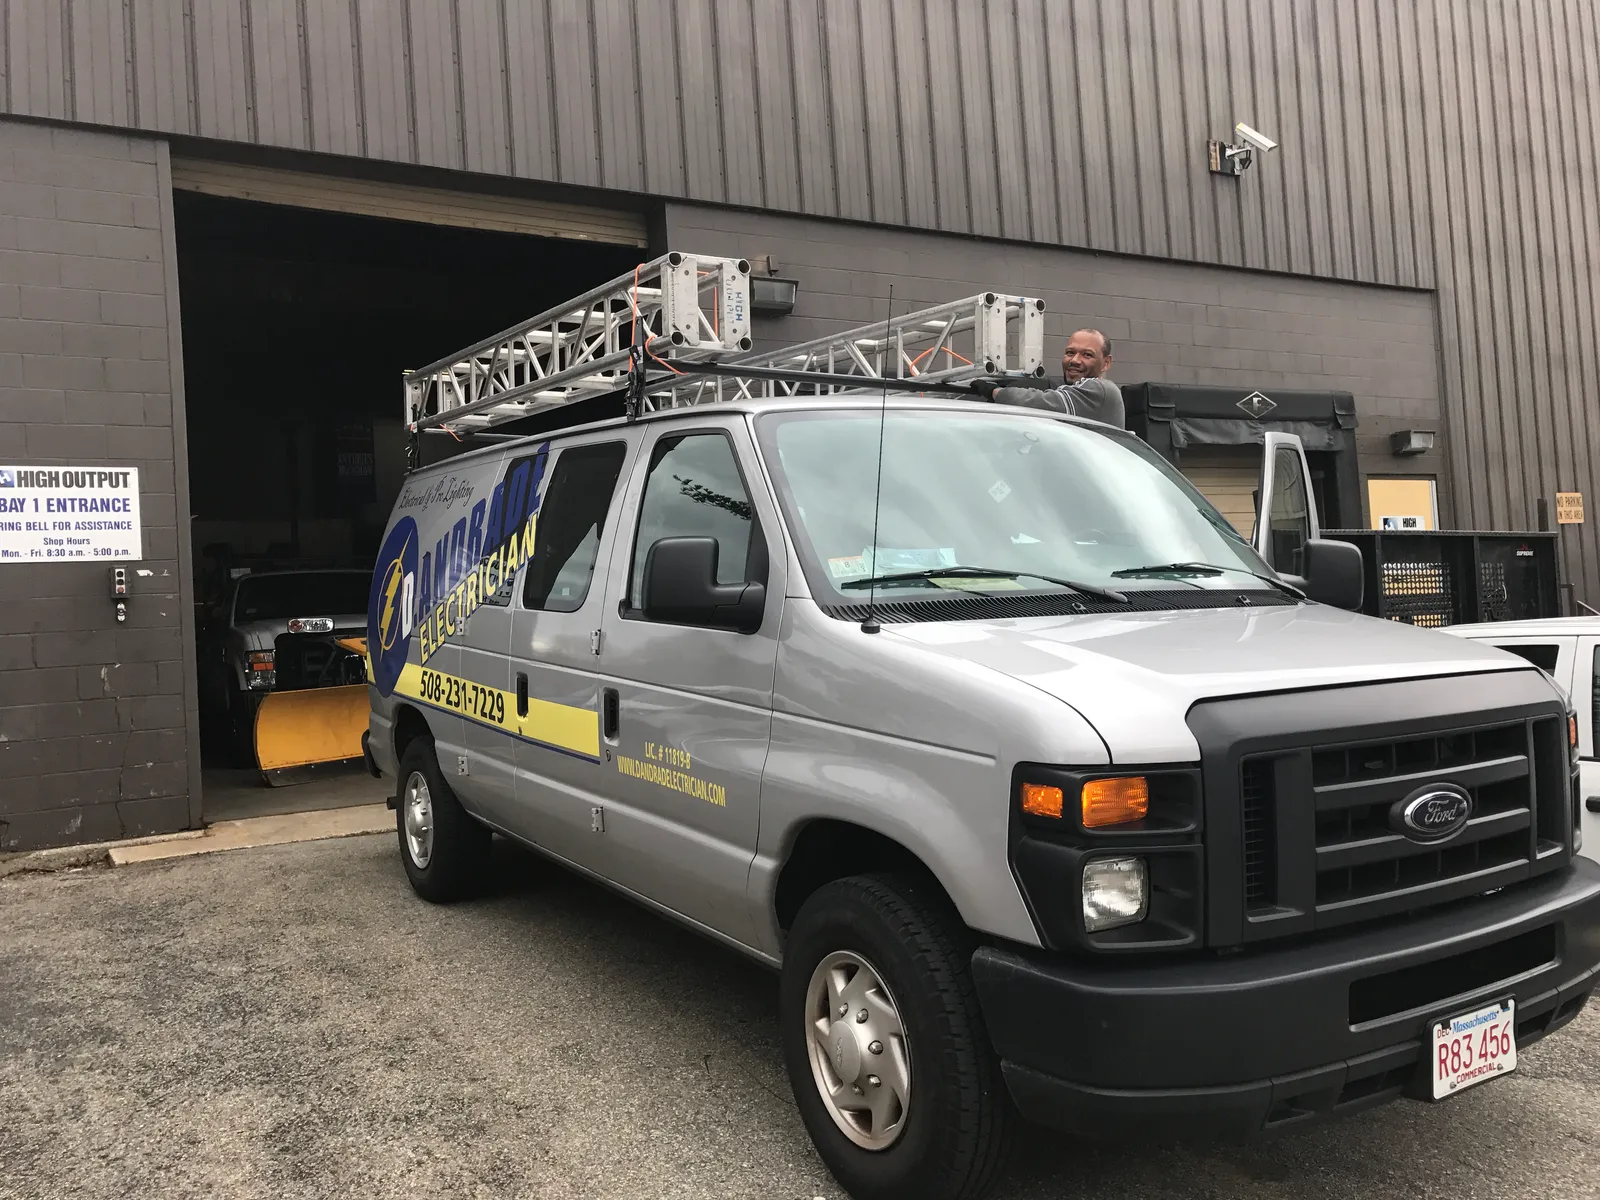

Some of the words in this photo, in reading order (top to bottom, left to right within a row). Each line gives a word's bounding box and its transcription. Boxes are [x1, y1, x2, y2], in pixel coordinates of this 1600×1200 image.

[735, 291, 743, 321] HIGH
[16, 470, 60, 488] HIGH
[62, 471, 131, 489] OUTPUT
[0, 497, 26, 513] BAY
[32, 497, 40, 513] 1
[46, 497, 131, 513] ENTRANCE
[1557, 496, 1564, 508] NO
[1565, 496, 1583, 508] PARKING
[0, 521, 22, 532] RING
[25, 521, 50, 531] BELL
[53, 521, 71, 531] FOR
[74, 520, 133, 531] ASSISTANCE
[1402, 517, 1417, 529] HIGH
[1558, 510, 1563, 520] IN
[1564, 510, 1573, 520] THIS
[1573, 510, 1583, 520] AREA
[43, 537, 64, 546] Shop
[66, 536, 91, 546] Hours
[1, 549, 22, 558] Mon.
[30, 549, 44, 558] Fri.
[46, 548, 66, 558] 8:30
[68, 549, 86, 557] a.m.
[93, 548, 112, 557] 5:00
[114, 549, 131, 558] p.m.
[419, 511, 538, 667] ELECTRICIAN
[420, 671, 505, 724] 508-231-7229
[644, 741, 658, 760] LIC.
[658, 745, 664, 761] #
[665, 747, 691, 769] 11819-B
[617, 754, 726, 807] WWW.DANDRADELECTRICIAN.COM
[1425, 799, 1458, 825] Ford
[1437, 1027, 1450, 1039] DEC
[1452, 1011, 1498, 1035] Massachusetts
[1438, 1032, 1473, 1081] R83
[1479, 1020, 1511, 1063] 456
[1456, 1062, 1497, 1085] COMMERCIAL
